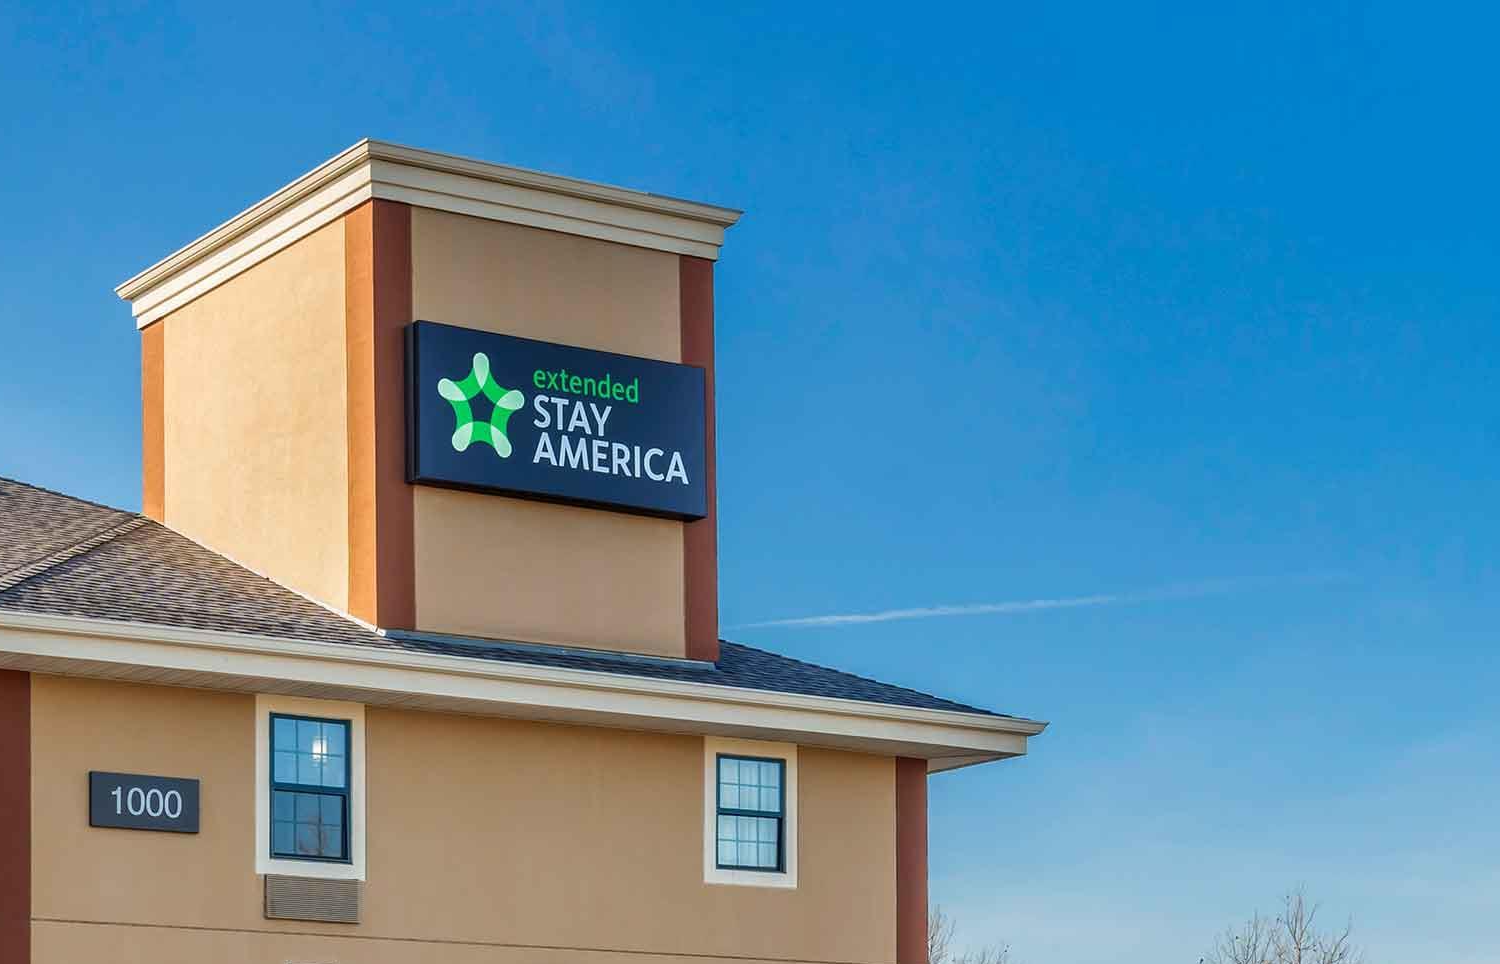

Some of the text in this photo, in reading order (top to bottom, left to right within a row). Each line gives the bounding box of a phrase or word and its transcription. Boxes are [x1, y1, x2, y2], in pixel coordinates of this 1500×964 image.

[533, 369, 639, 403] extended
[533, 394, 612, 437] STAY
[532, 432, 689, 485] AMERICA
[111, 786, 182, 819] 1000
